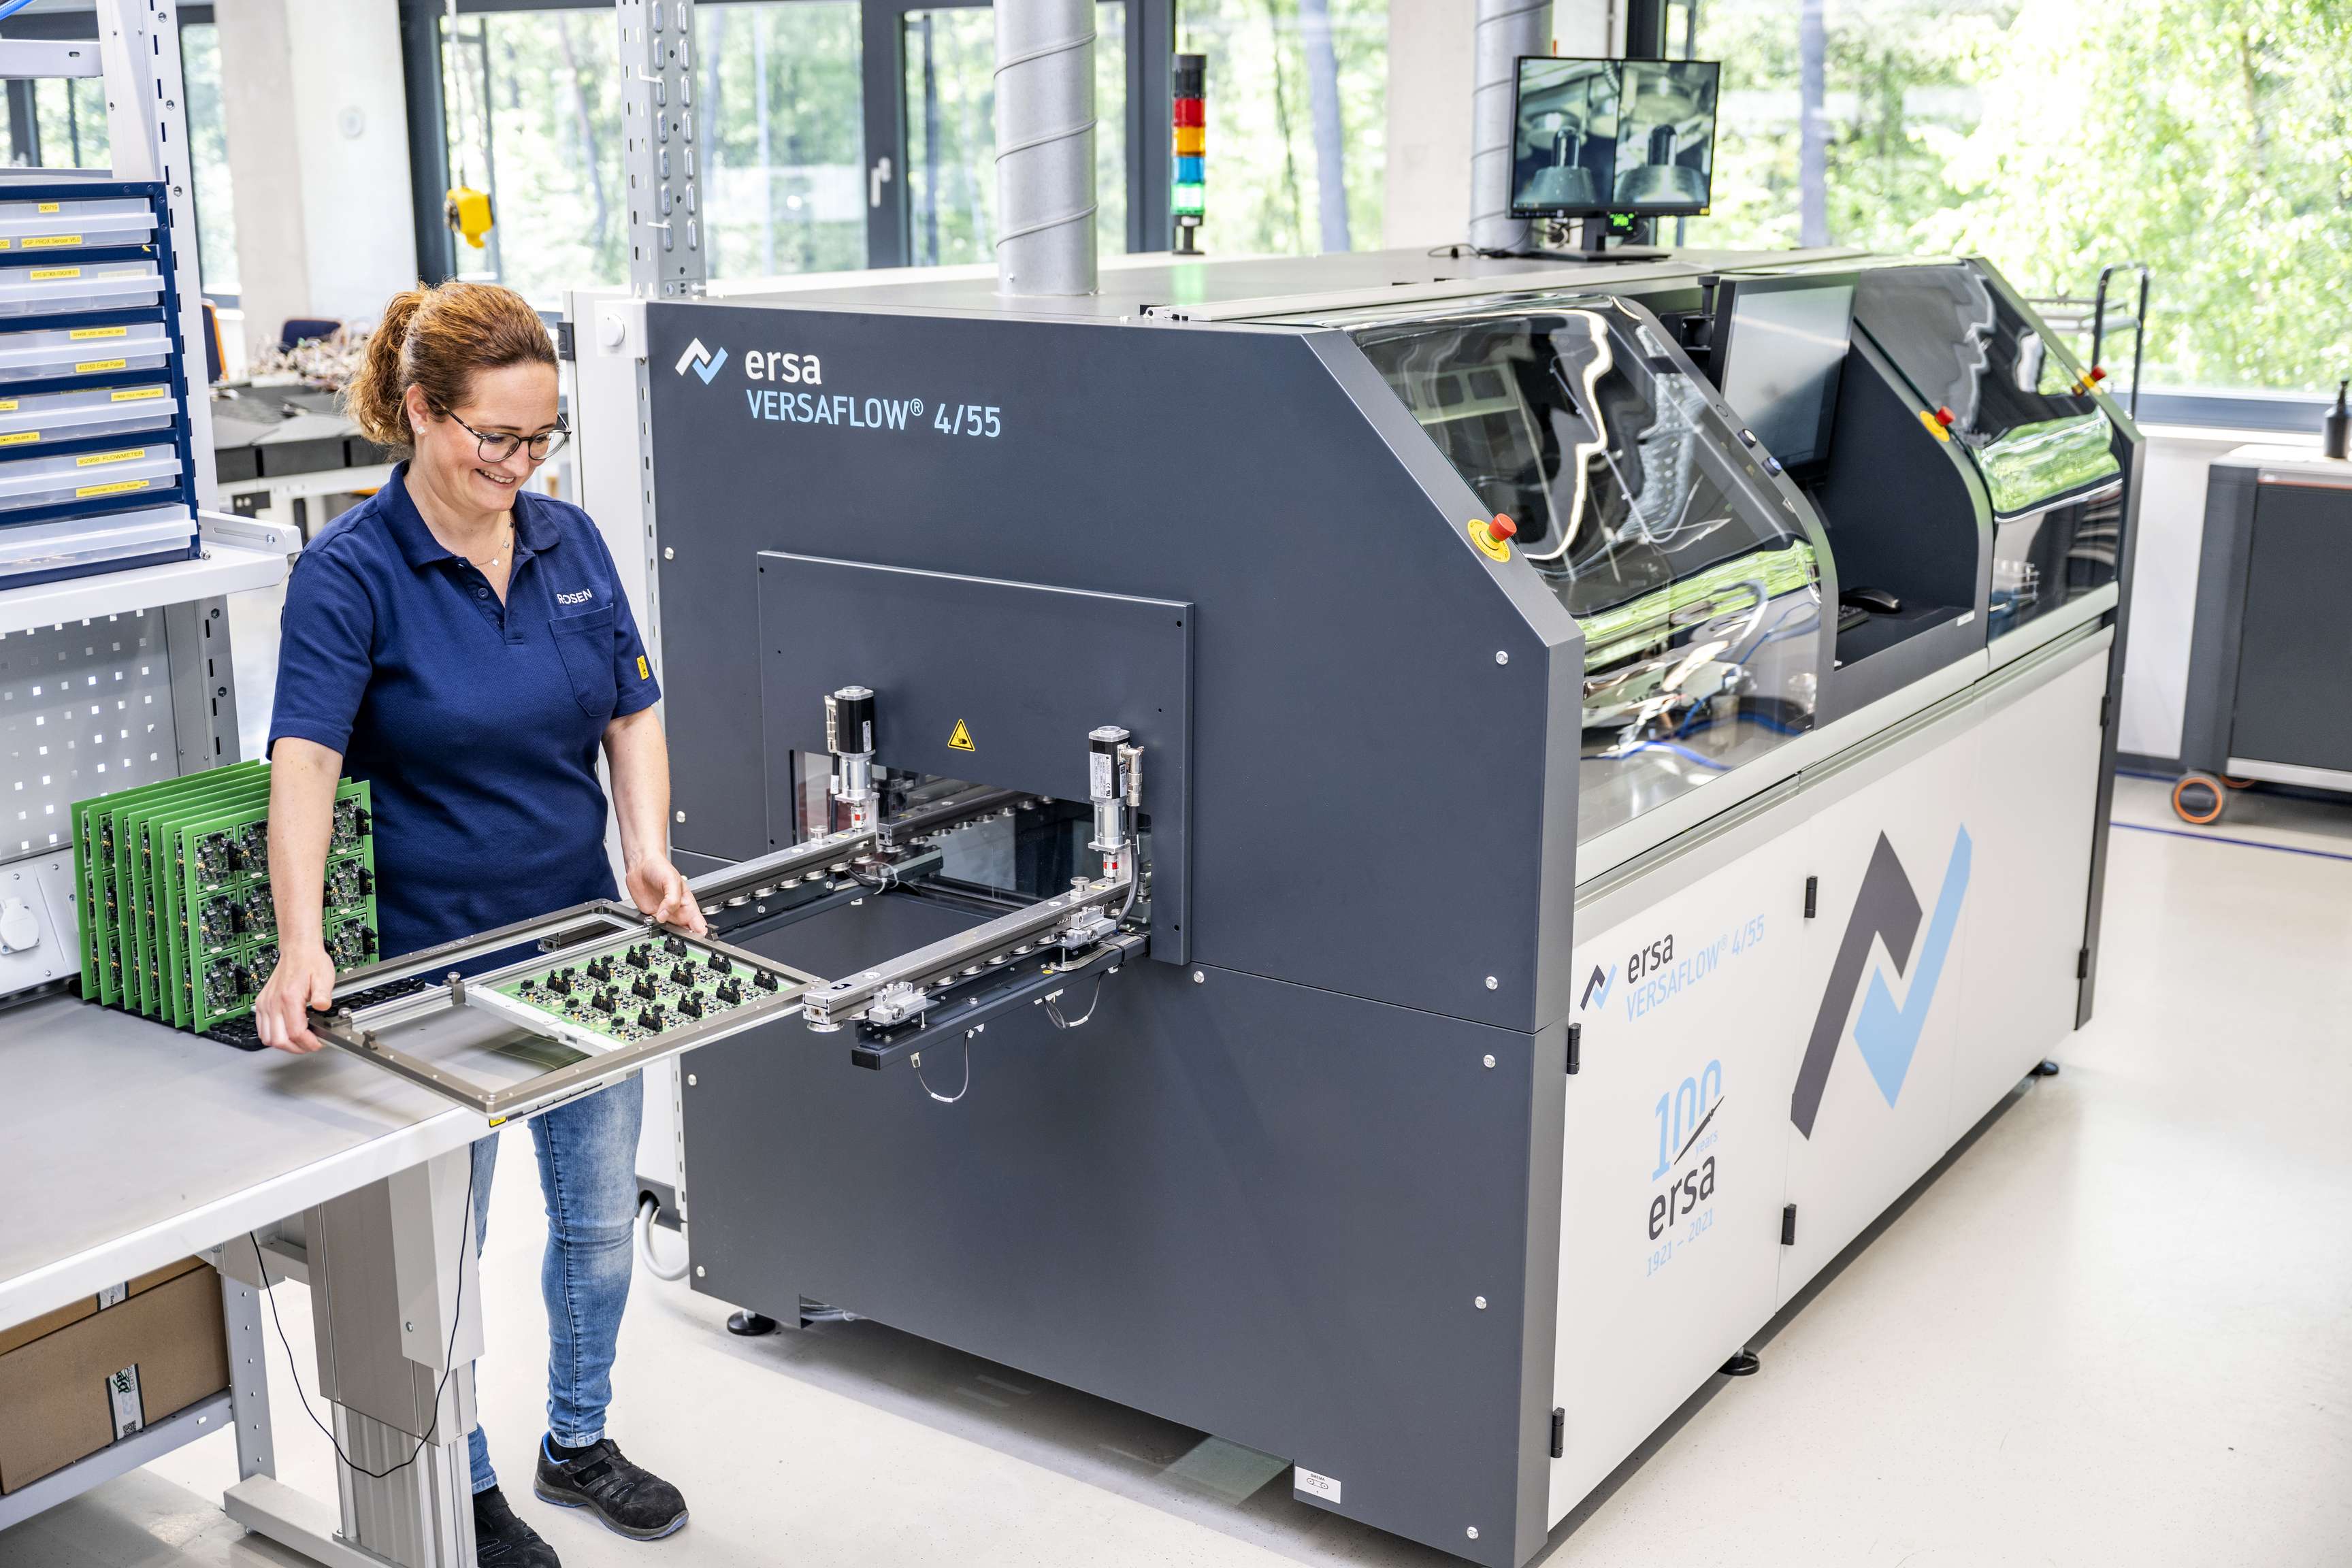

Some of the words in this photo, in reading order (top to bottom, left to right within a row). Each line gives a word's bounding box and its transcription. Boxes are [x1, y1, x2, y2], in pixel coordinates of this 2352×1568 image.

[745, 350, 822, 385] ersa
[934, 403, 1002, 438] 4/55
[103, 451, 143, 461] FLOWMETER
[557, 589, 593, 604] ROSEN
[1731, 913, 1765, 956] 4/55
[1628, 934, 1673, 984] ersa
[1695, 1130, 1719, 1160] years
[1649, 1156, 1716, 1240] ersa
[1646, 1240, 1672, 1277] 1921
[1688, 1208, 1714, 1243] 2021
